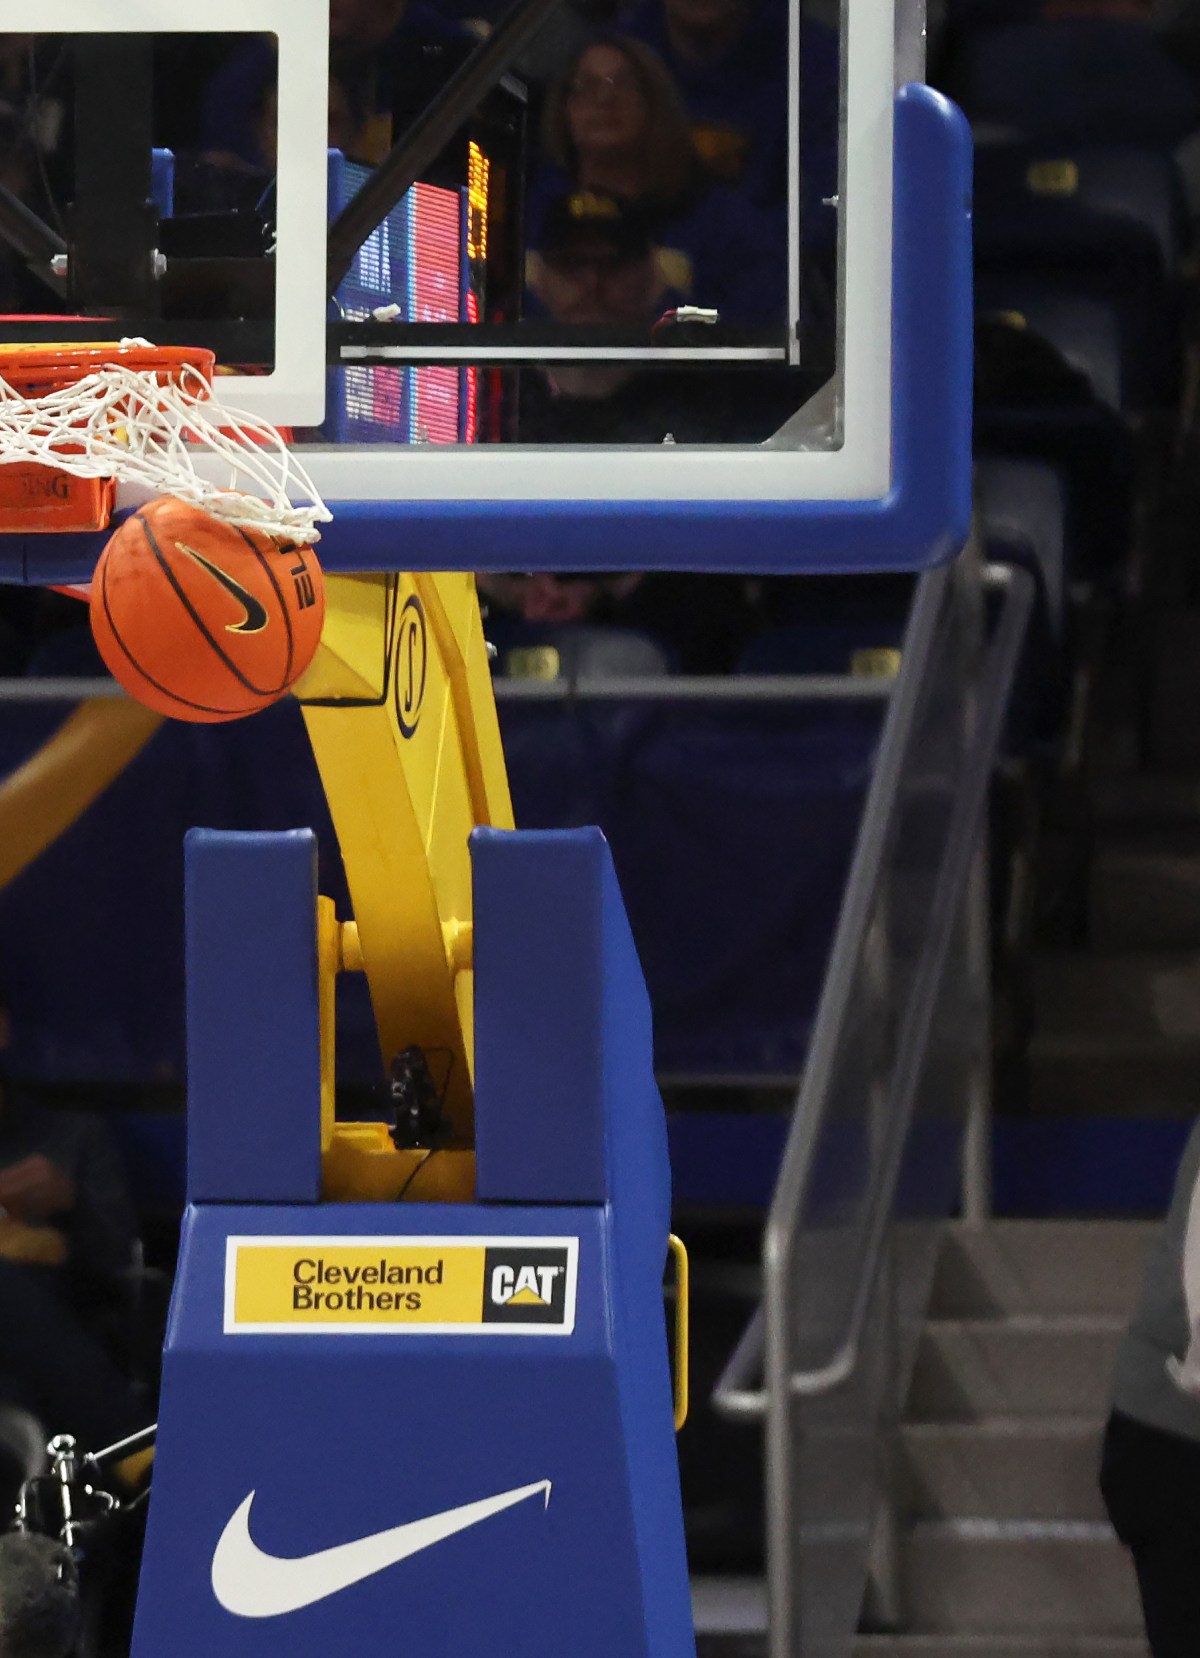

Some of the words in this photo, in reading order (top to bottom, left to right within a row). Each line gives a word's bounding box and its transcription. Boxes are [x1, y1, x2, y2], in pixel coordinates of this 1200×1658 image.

[293, 1258, 443, 1285] Cleveland
[491, 1264, 559, 1306] CAT
[292, 1285, 422, 1311] Brothers
